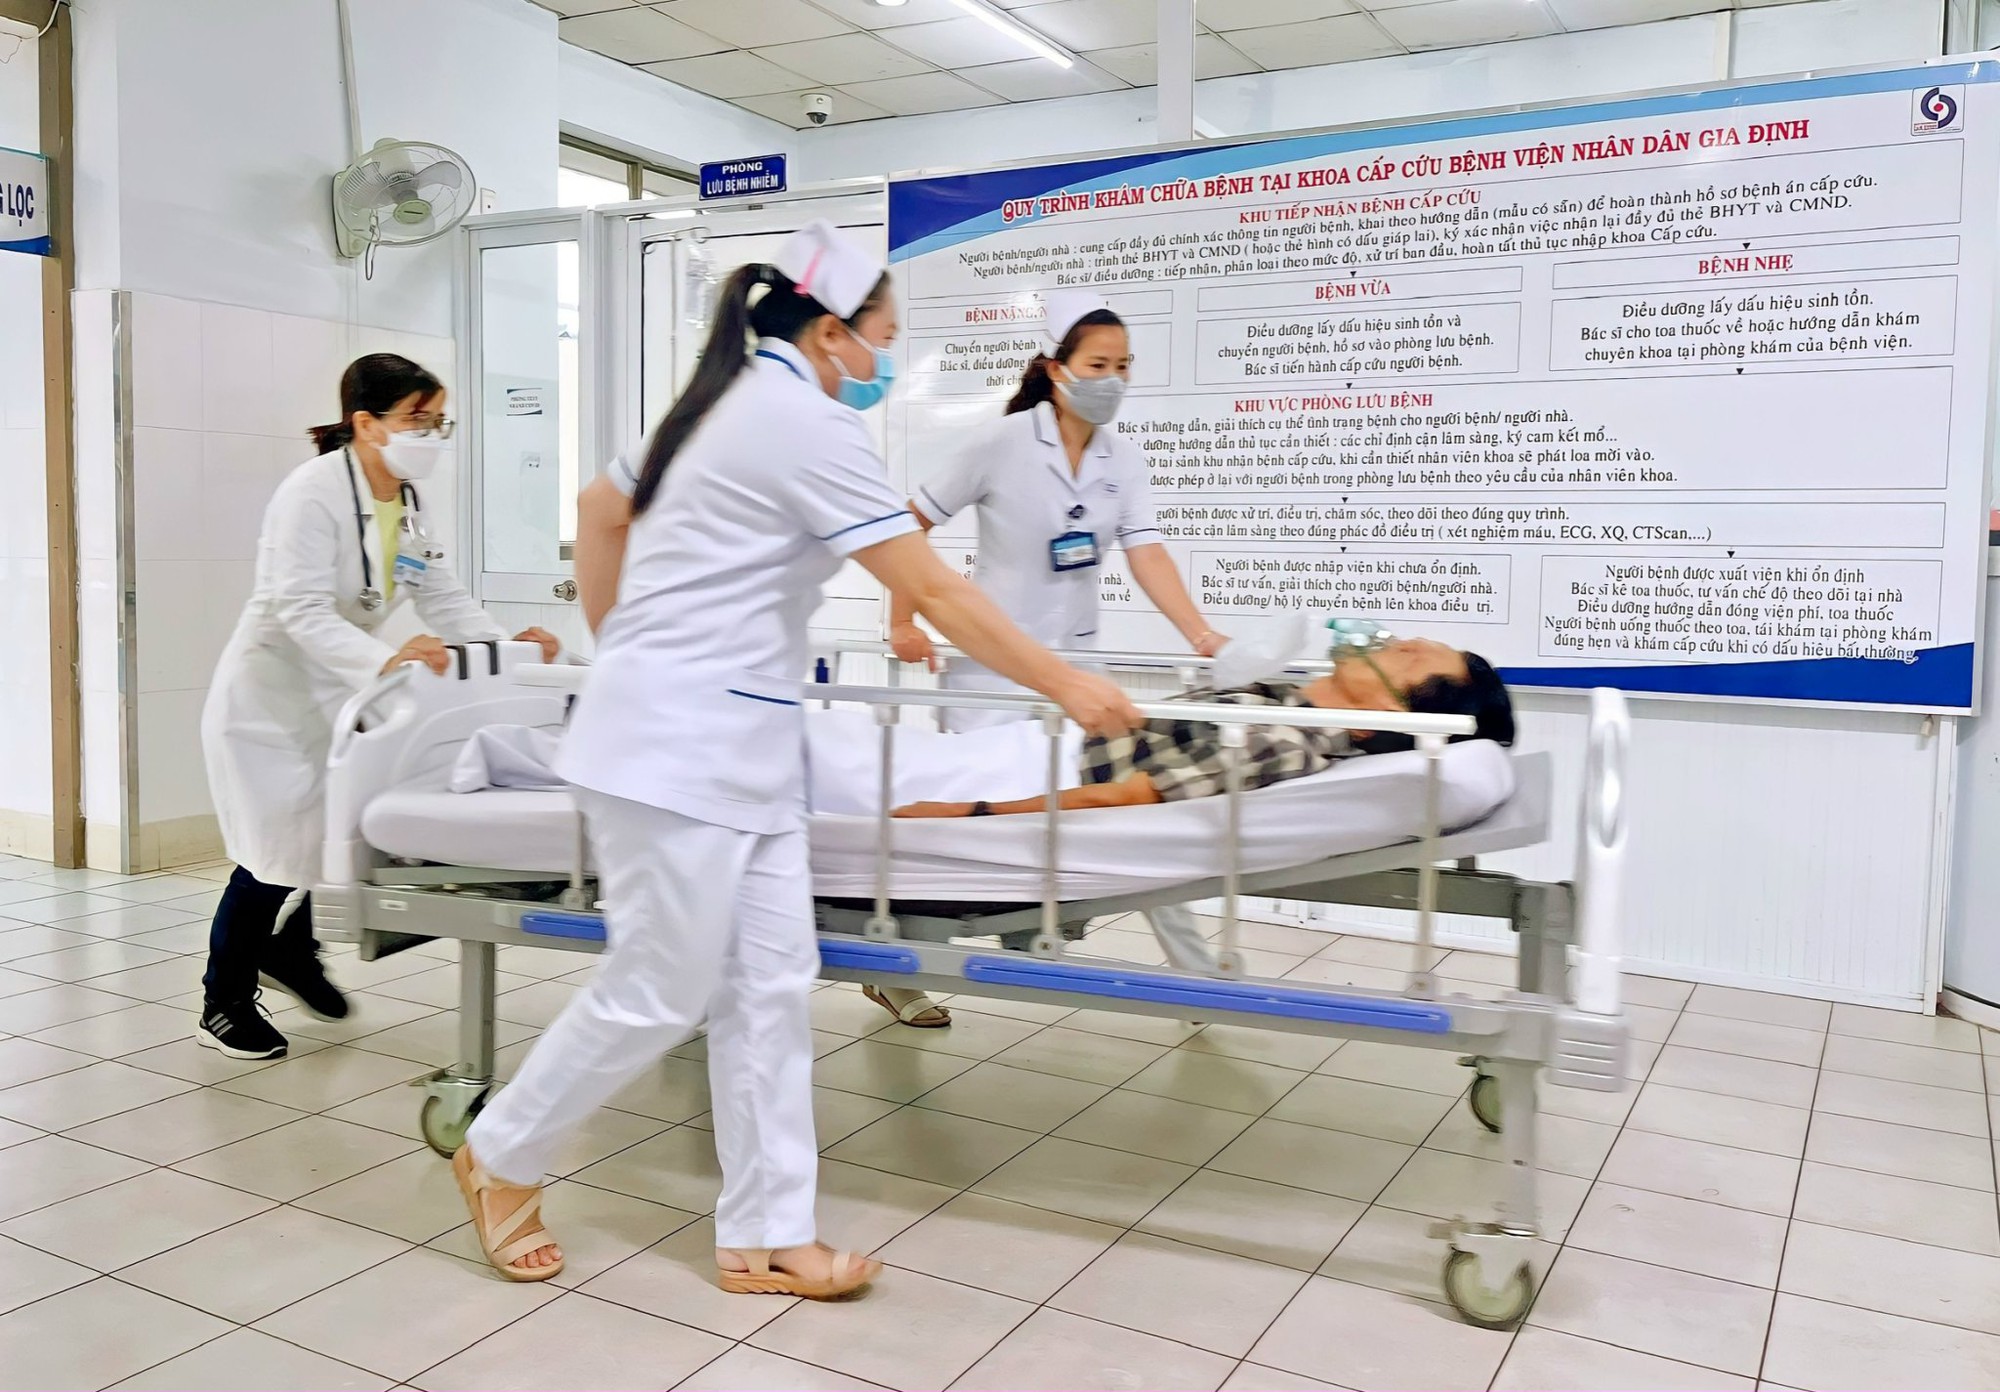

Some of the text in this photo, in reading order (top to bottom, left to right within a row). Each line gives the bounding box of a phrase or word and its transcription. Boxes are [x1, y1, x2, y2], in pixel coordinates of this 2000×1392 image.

[722, 161, 763, 174] PHÒNG
[1003, 119, 1809, 223] QUY TRÌNH KHÁM CHỮA BỆNH TẠI KHOA CẤP CỨU BỆNH VIỆN NHÂN DÂN GIA ĐỊNH
[706, 170, 778, 195] LƯU BỆNH NHIỄM
[8, 183, 34, 227] LỌC
[1107, 238, 1126, 253] cấp
[1129, 235, 1149, 250] đầy
[1152, 235, 1165, 247] đủ
[1169, 232, 1199, 245] chính
[1203, 231, 1223, 242] xác
[1226, 229, 1259, 242] thông
[1263, 226, 1278, 237] tin
[1282, 222, 1315, 239] người
[1357, 216, 1384, 230] khai
[1388, 216, 1416, 227] theo
[1463, 206, 1488, 221] dẫn
[1492, 203, 1527, 220] (mẫu
[1531, 203, 1548, 215] có
[1586, 195, 1605, 211] để
[1609, 195, 1644, 209] hoàn
[1650, 190, 1691, 206] thành
[1719, 187, 1737, 200] sơ
[1742, 182, 1780, 199] bệnh
[1785, 180, 1804, 194] án
[1809, 174, 1839, 194] cấp
[1843, 174, 1877, 188] cứu.
[1239, 188, 1481, 224] KHU TIẾP NHẬN BỆNH CẤP CỨU
[1698, 254, 1793, 276] BỆNH NHẸ
[1315, 279, 1390, 301] BỆNH VỪA
[965, 307, 998, 323] BỆNH
[1660, 302, 1705, 318] dưỡng
[1710, 296, 1732, 316] lấy
[1736, 294, 1764, 312] dấu
[1769, 295, 1802, 312] hiệu
[1807, 292, 1838, 308] sinh
[1580, 327, 1606, 340] Bác
[1610, 326, 1622, 339] sĩ
[1625, 325, 1651, 338] cho
[1655, 327, 1676, 337] toa
[1681, 318, 1720, 336] thuốc
[1725, 317, 1743, 333] về
[1748, 319, 1784, 334] hoặc
[1841, 311, 1870, 328] dẫn
[1875, 311, 1919, 326] khám
[1584, 334, 1912, 363] chuyên khoa tại phòng khám của bệnh viện.
[1234, 391, 1432, 413] KHU VỰC PHÒNG LƯU BỆNH
[1605, 564, 1864, 585] Người bệnh được xuất viện khi ổn định
